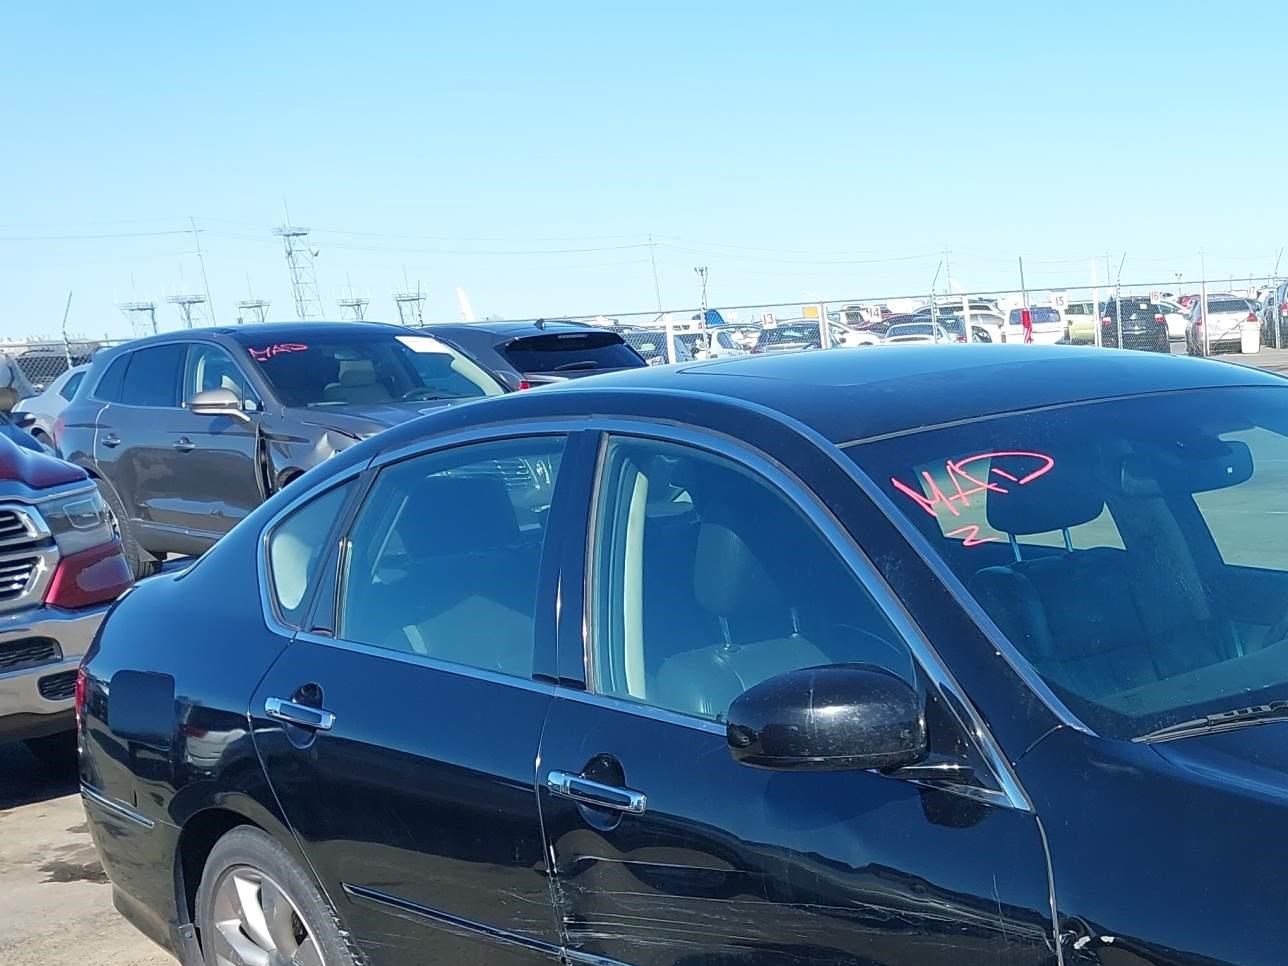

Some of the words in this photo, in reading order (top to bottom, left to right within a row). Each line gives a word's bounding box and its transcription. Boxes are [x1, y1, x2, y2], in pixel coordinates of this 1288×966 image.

[1151, 290, 1159, 301] 16
[1055, 296, 1065, 307] 15
[869, 307, 880, 318] 14
[763, 312, 775, 325] 13
[890, 451, 1055, 517] MAD
